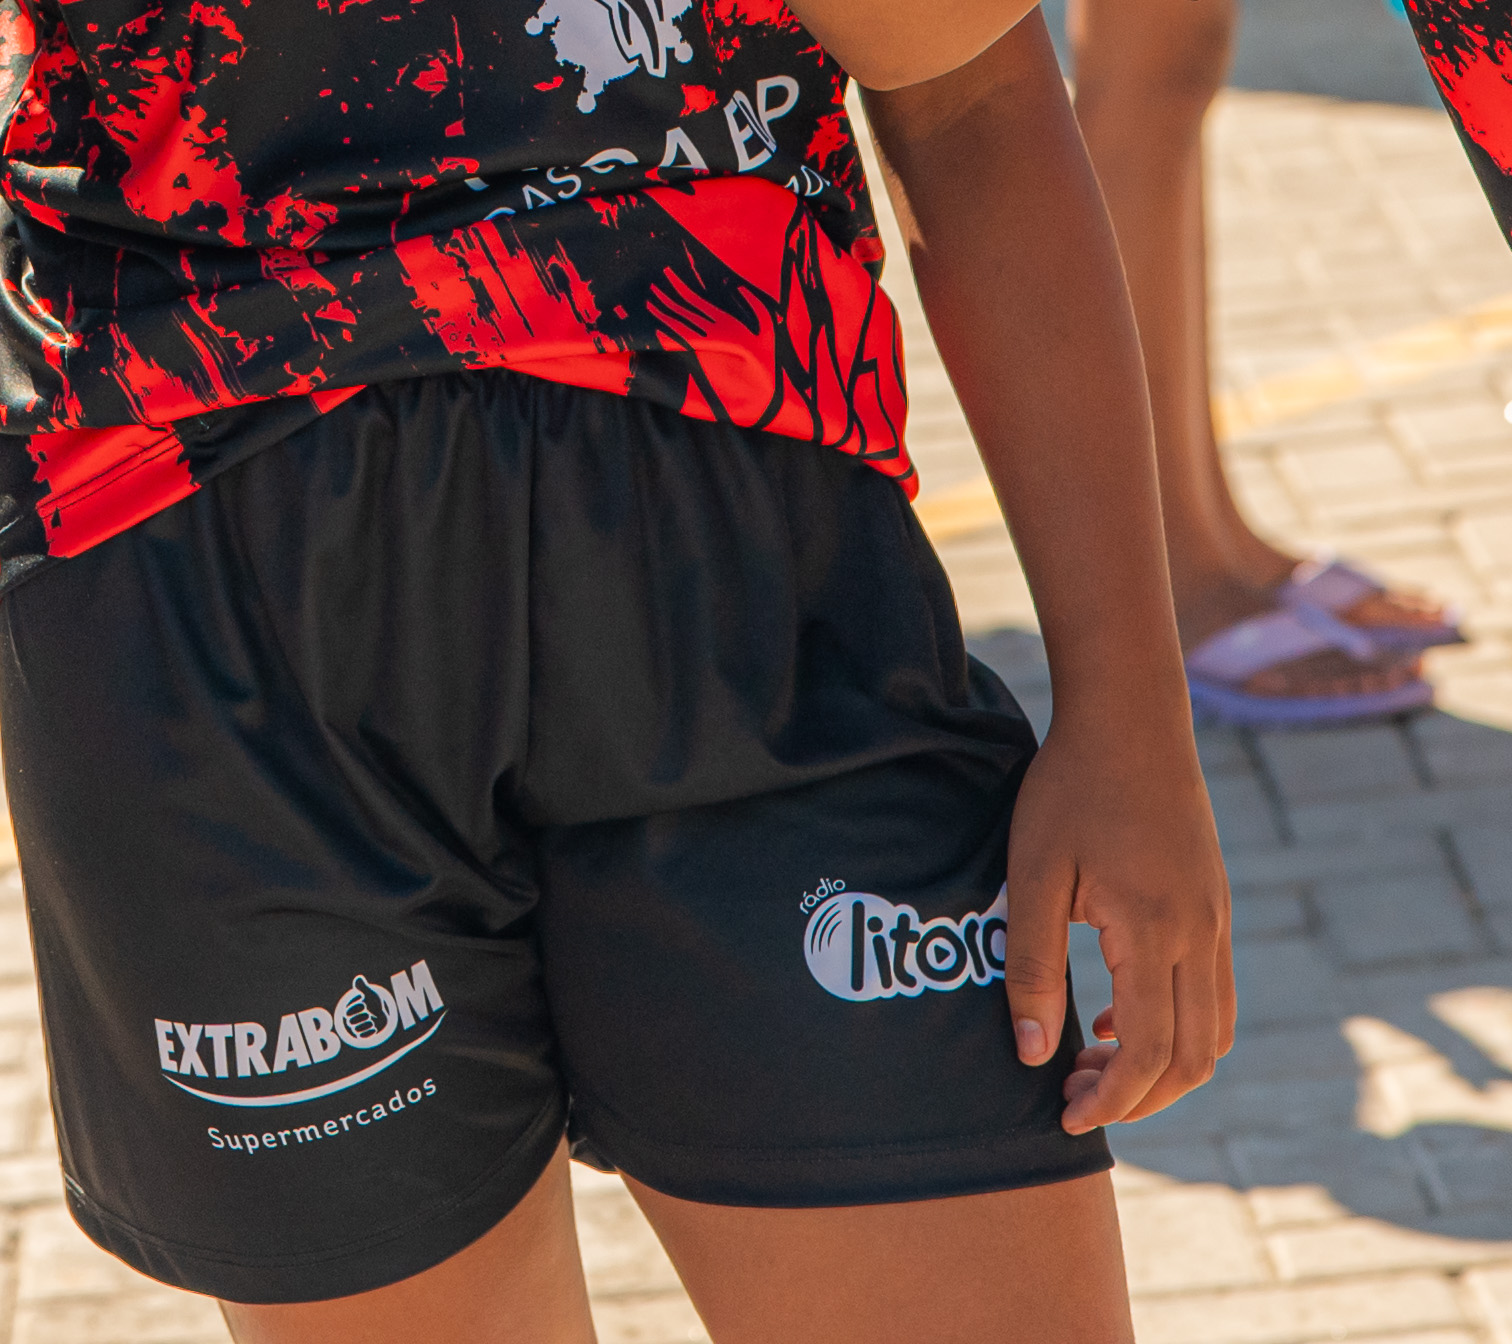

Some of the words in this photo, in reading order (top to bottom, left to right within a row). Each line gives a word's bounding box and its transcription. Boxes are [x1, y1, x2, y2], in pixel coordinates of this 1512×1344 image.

[799, 877, 846, 915] rádio
[154, 959, 446, 1079] EXTRABOM
[207, 1078, 438, 1155] Supermercados
